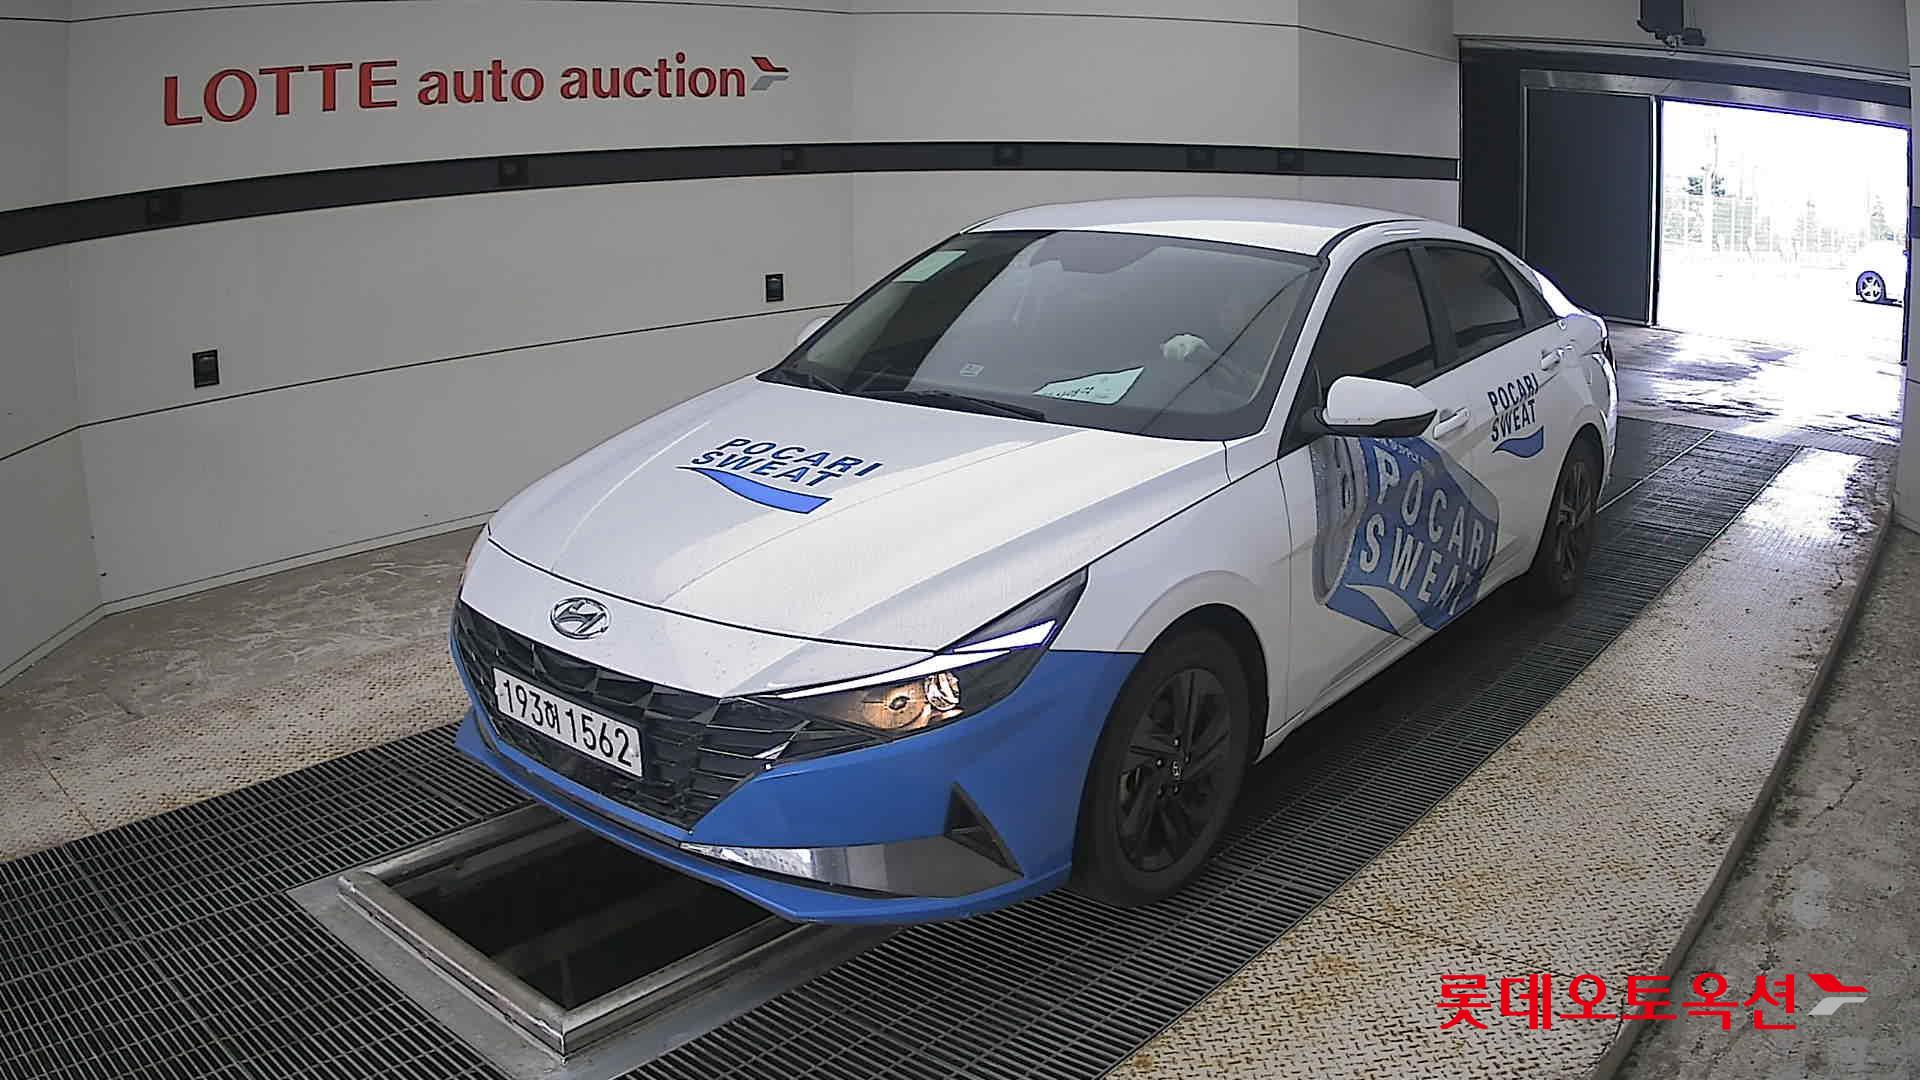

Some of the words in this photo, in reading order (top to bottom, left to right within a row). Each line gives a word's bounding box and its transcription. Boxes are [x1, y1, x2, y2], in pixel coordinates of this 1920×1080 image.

[163, 60, 398, 126] LOTTE
[417, 58, 545, 105] auto
[560, 51, 746, 99] auction
[1487, 373, 1539, 416] POCARI
[1491, 399, 1536, 441] SWEAT
[692, 451, 842, 486] SWEAT
[716, 438, 883, 476] POCARI
[1374, 445, 1496, 570] POCARI
[565, 708, 632, 767] 1562
